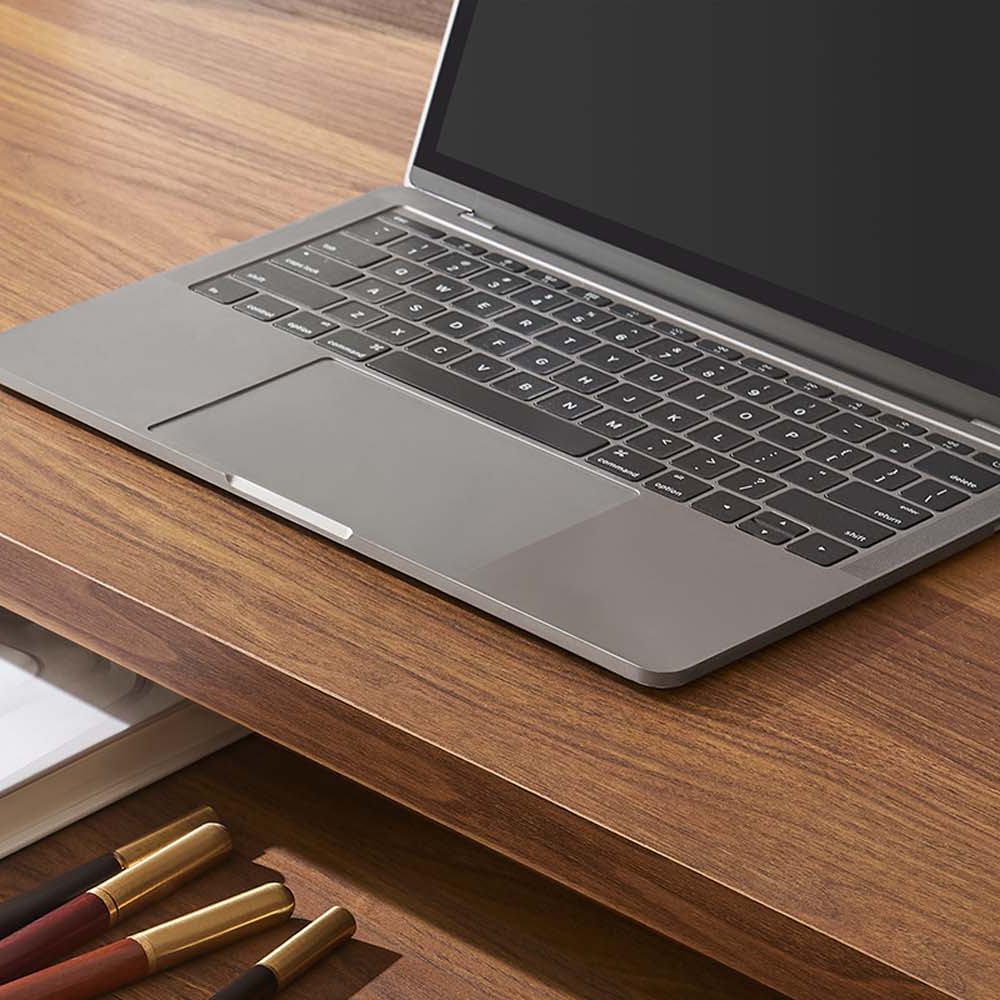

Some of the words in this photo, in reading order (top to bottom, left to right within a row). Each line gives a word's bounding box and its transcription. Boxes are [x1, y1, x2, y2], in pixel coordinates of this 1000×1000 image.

[395, 268, 408, 276] Q
[435, 284, 452, 293] W
[409, 304, 423, 312] S
[477, 302, 491, 310] E
[350, 311, 365, 319] Z
[449, 321, 463, 329] D
[519, 319, 532, 327] R
[391, 328, 405, 336] X
[434, 346, 447, 354] C
[578, 376, 593, 384] H
[649, 374, 663, 382] U
[519, 383, 532, 391] B
[562, 401, 577, 410] N
[667, 414, 681, 422] K
[739, 412, 753, 420] O
[606, 420, 623, 429] M
[713, 434, 723, 442] L
